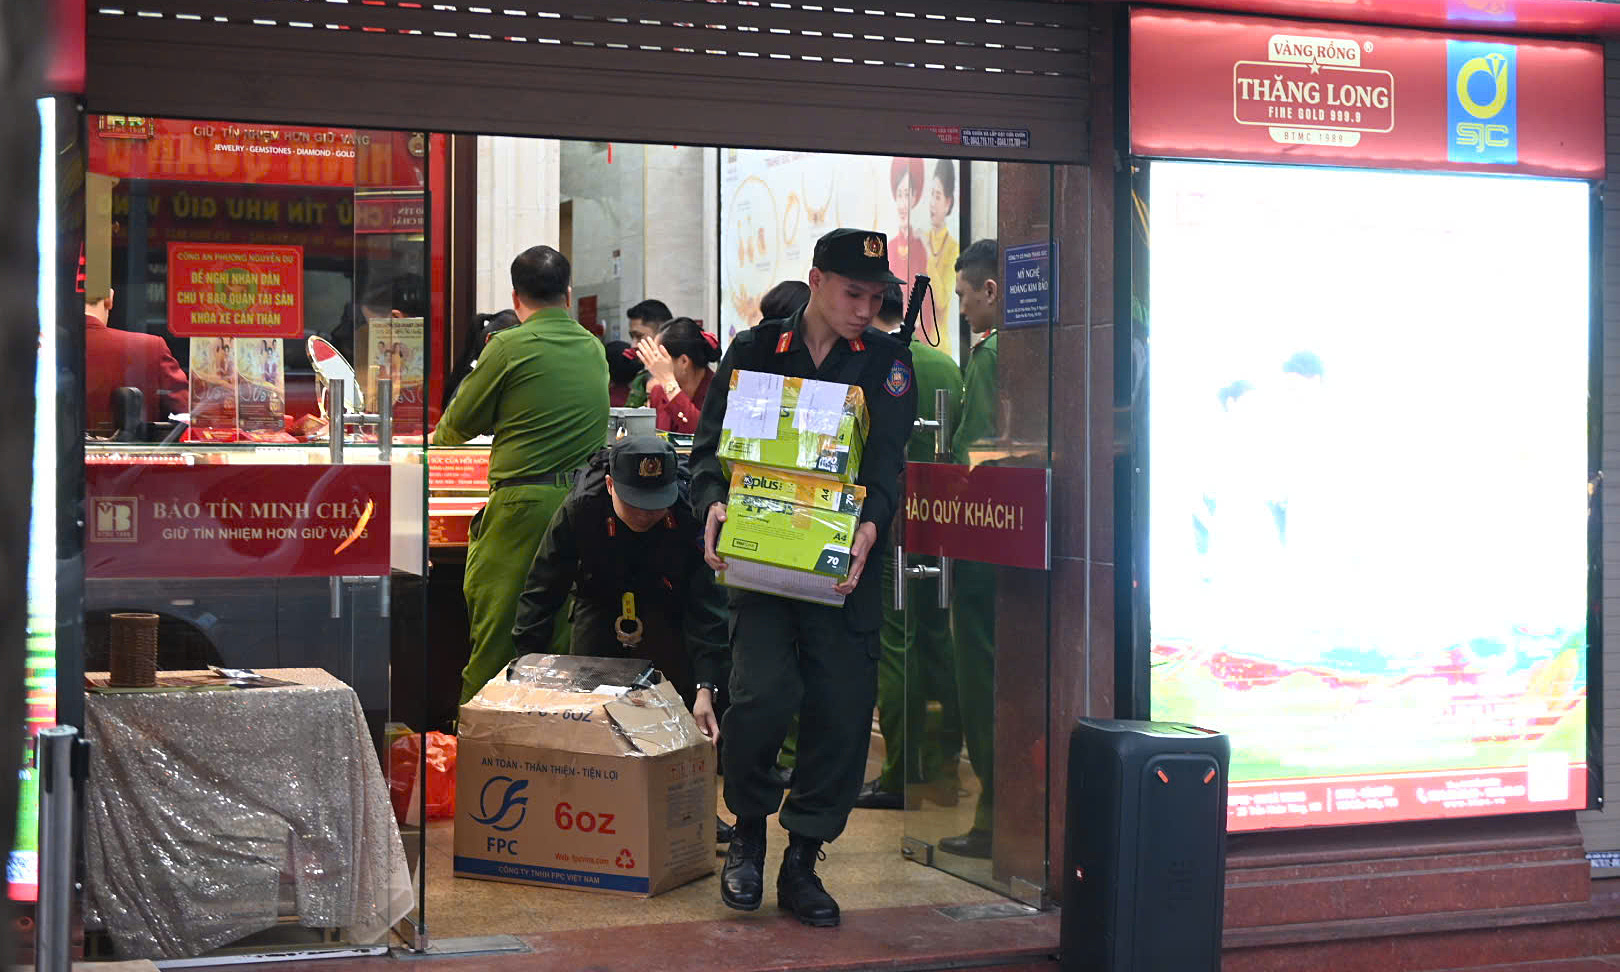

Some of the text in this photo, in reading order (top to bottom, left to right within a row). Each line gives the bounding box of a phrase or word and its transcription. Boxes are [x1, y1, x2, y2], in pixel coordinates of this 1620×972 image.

[1273, 40, 1356, 60] VÀNG RỒNG
[1237, 74, 1389, 109] THĂNG LONG
[1269, 106, 1361, 123] FINE GOLD 999.9
[1285, 131, 1343, 143] BTMC 1989
[213, 143, 355, 158] JEWELRY GEMSTONES DIAMOND GOLD
[219, 312, 232, 324] XE
[821, 488, 830, 501] A4
[845, 493, 855, 506] 70
[153, 498, 200, 519] BẢO
[207, 498, 243, 518] TÍN
[250, 502, 309, 518] MINH
[933, 496, 961, 524] QUÝ
[965, 498, 1015, 530] KHÁCH
[162, 526, 189, 539] GIỮ
[192, 526, 214, 539] TÍN
[219, 528, 263, 542] NHIỆM
[266, 527, 297, 539] HƠN
[301, 525, 328, 539] GIỮ
[833, 532, 848, 542] A4
[827, 556, 840, 566] 70
[482, 757, 493, 767] AN
[495, 756, 518, 769] TOÀN
[525, 761, 547, 773] THÂN
[551, 764, 575, 778] THIỆN
[582, 767, 601, 780] TIỆN
[554, 802, 616, 835] 6oz
[487, 837, 518, 856] FPC
[498, 865, 600, 885] CÔNG TY TNHH FPC VIỆT NAM
